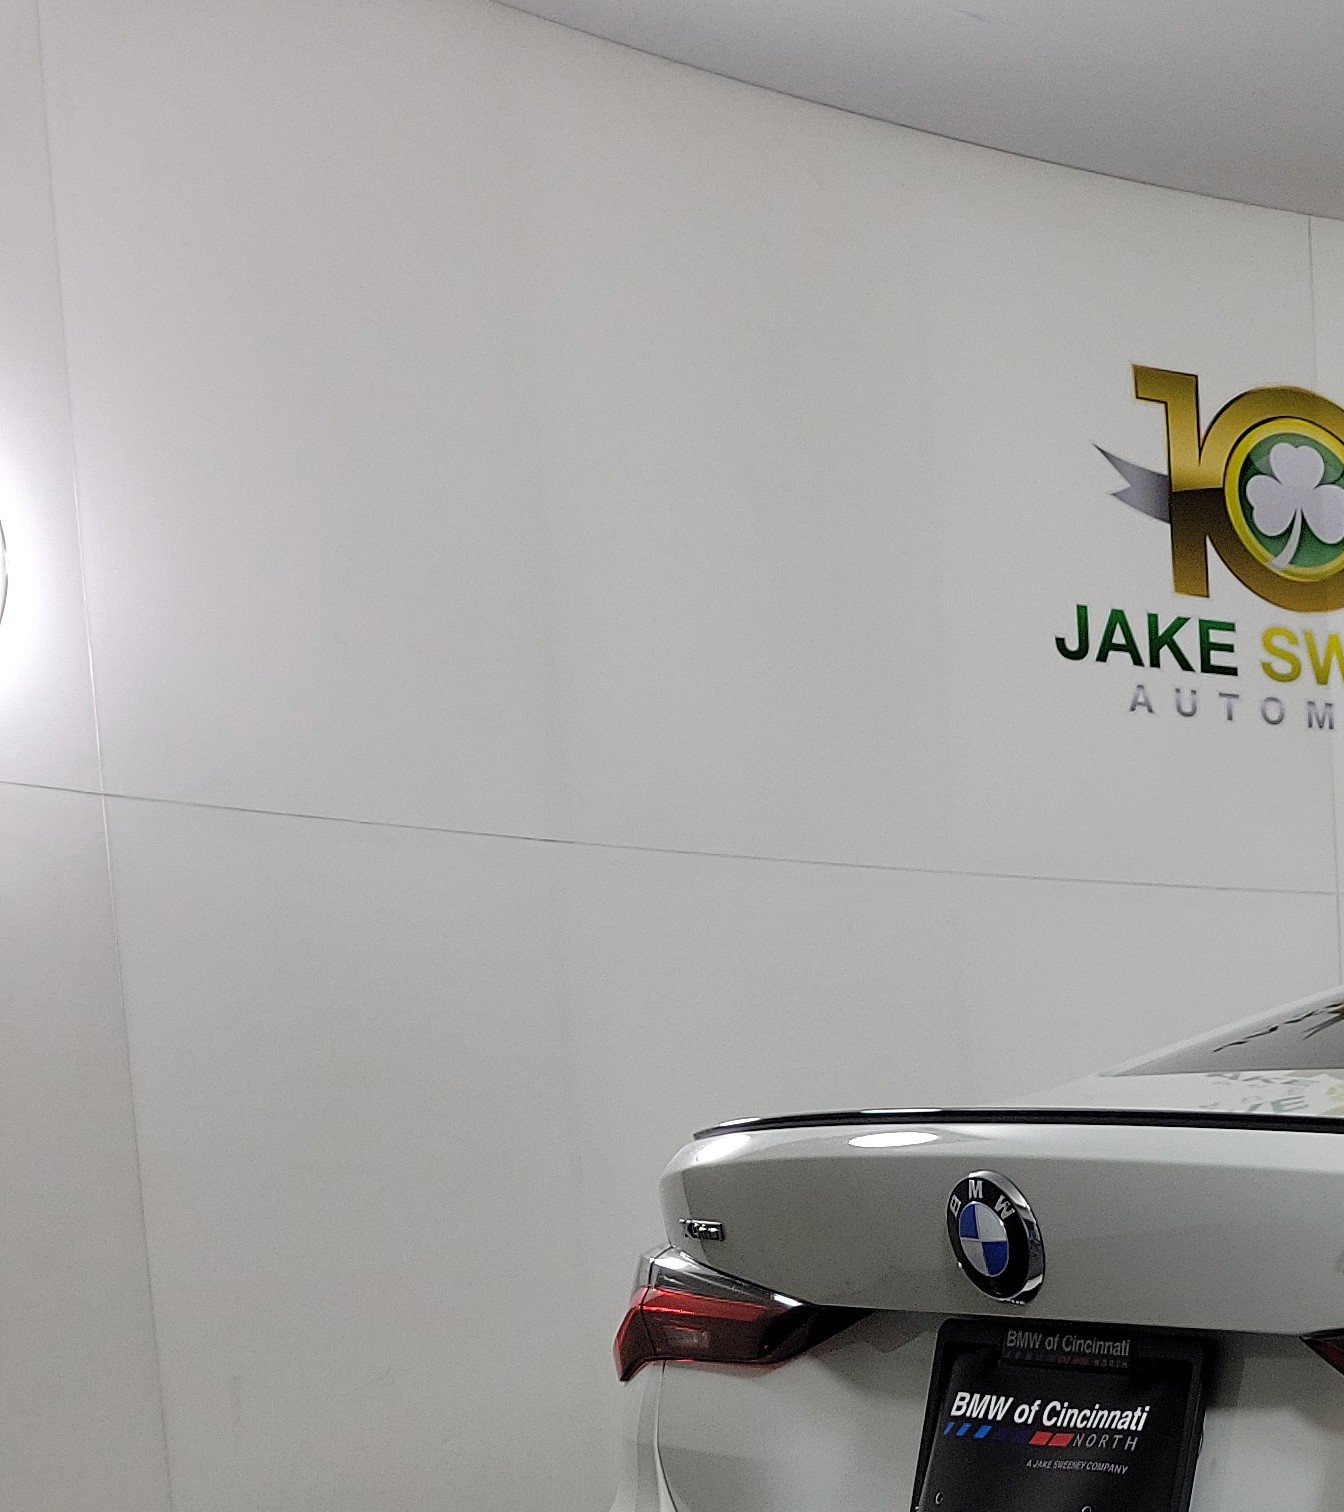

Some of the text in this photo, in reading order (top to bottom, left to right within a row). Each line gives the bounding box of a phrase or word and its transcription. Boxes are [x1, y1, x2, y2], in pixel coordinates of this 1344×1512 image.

[1055, 603, 1239, 677] JAKE
[948, 1179, 1017, 1219] BMW
[1006, 1329, 1130, 1357] BMW of Cincinnati
[950, 1391, 1150, 1431] BMW of Cincinnati
[1072, 1432, 1139, 1452] NORTH
[1086, 1462, 1129, 1475] COMPANY
